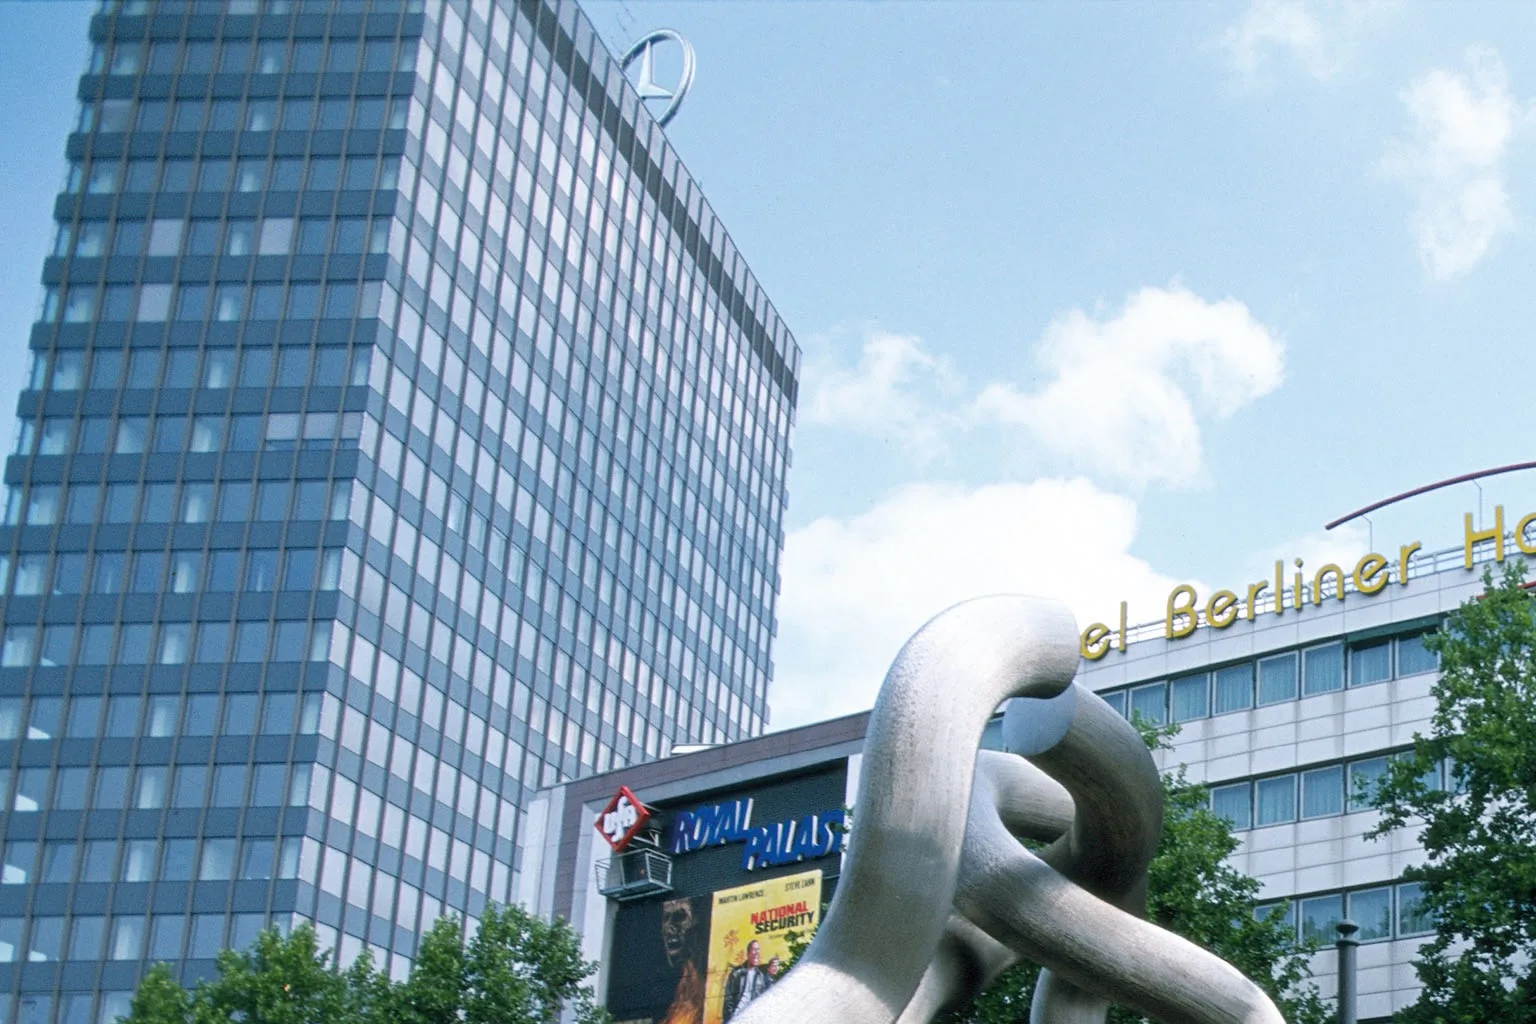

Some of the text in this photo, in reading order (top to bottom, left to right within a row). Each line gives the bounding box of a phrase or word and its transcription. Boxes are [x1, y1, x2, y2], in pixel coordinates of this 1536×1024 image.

[1165, 540, 1422, 641] Berliner
[671, 797, 754, 854] ROYAL
[718, 894, 738, 905] MARTIN
[750, 900, 809, 925] NATIONAL
[755, 911, 815, 935] SECURITY
